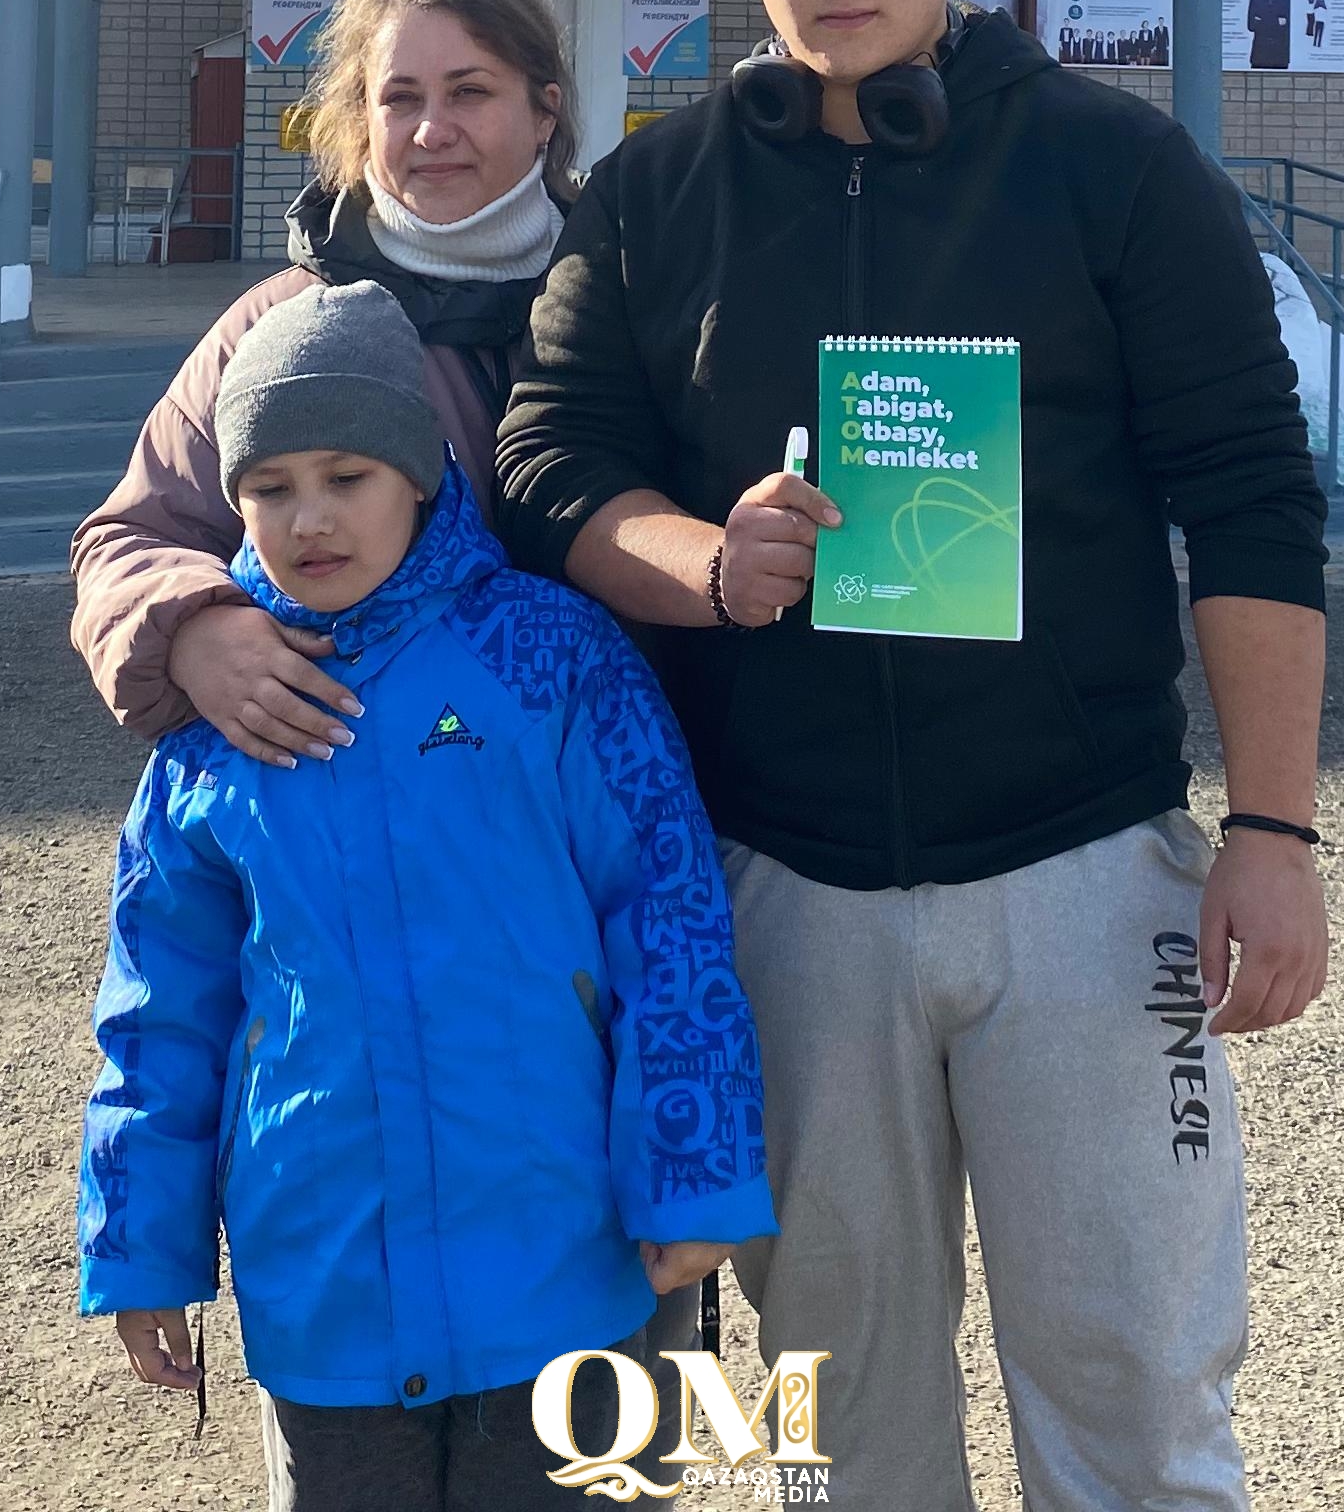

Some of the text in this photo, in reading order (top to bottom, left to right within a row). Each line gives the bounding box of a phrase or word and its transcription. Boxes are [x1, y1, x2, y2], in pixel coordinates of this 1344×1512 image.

[272, 0, 323, 10] РЕФЕРЕНДУМ
[642, 12, 690, 22] РЕФЕРЕНДУМ
[840, 370, 931, 398] Adam,
[840, 394, 954, 423] Tabigat,
[840, 420, 946, 448] Otbasy,
[840, 445, 979, 470] Memleket
[1143, 930, 1211, 1166] CHINESE
